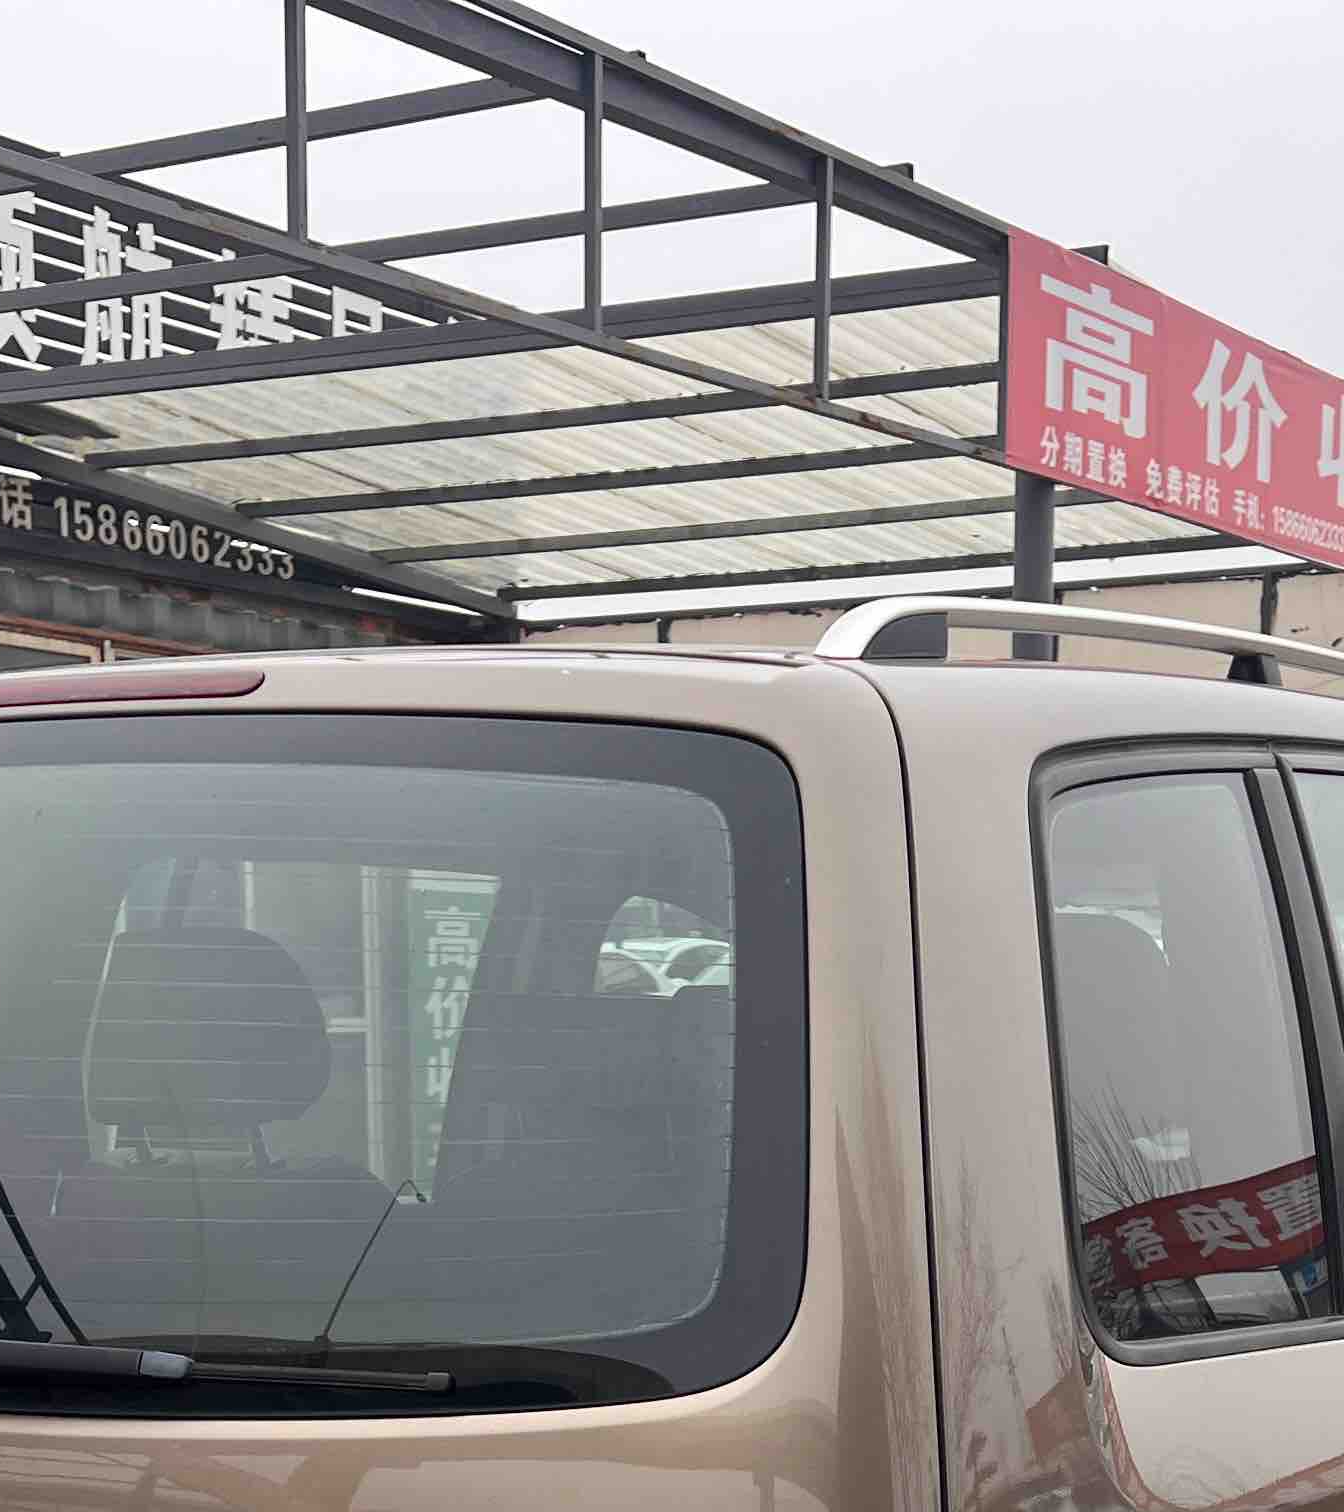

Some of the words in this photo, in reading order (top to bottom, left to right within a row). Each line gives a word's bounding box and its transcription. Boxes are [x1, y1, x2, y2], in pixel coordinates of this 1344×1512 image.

[1040, 425, 1127, 489] 分期置换
[1145, 458, 1221, 517] 免费评估
[53, 495, 295, 581] 15866062333
